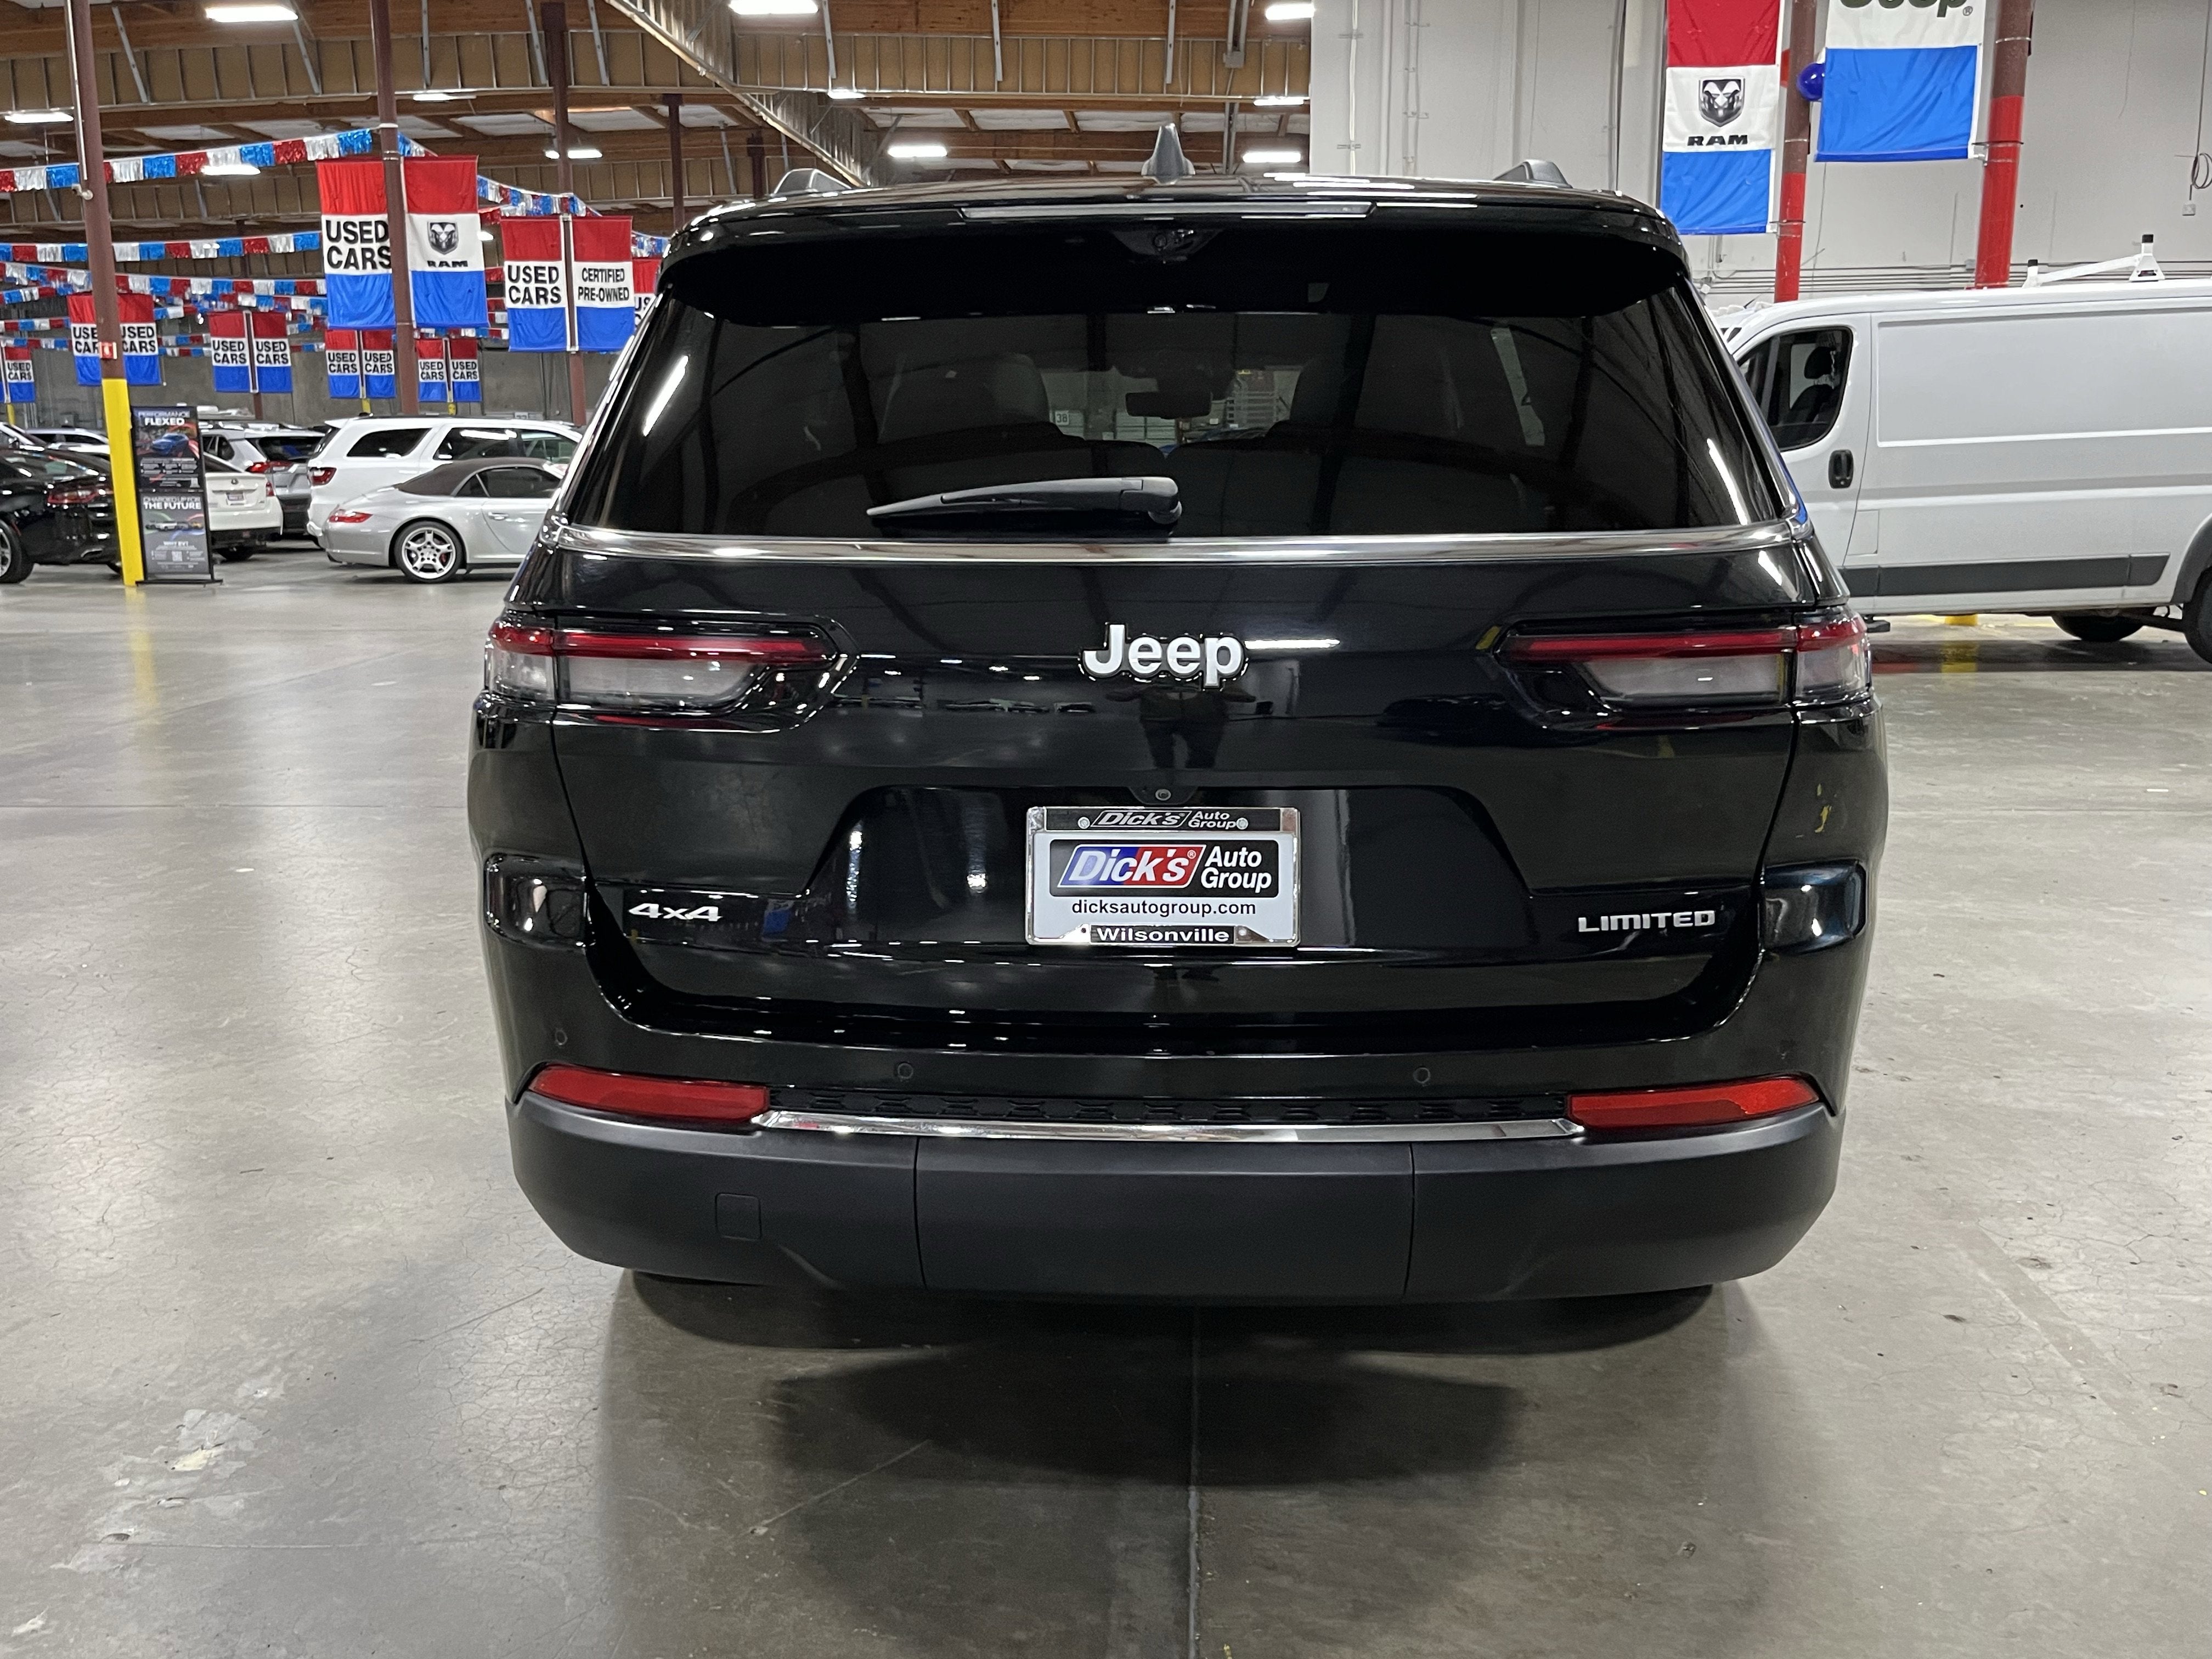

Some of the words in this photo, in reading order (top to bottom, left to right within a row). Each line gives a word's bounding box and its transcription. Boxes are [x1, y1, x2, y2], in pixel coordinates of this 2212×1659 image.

[1688, 135, 1748, 146] RAM
[325, 219, 390, 245] USED
[327, 246, 392, 270] CARS
[507, 265, 560, 284] USED
[582, 267, 625, 283] CERTIFIED
[509, 285, 562, 305] CARS
[578, 286, 630, 302] PRE-OWNED
[74, 326, 98, 339] USE
[75, 341, 99, 353] CAR
[122, 341, 156, 353] CARS
[213, 340, 245, 352] USED
[256, 341, 287, 352] USED
[213, 353, 247, 364] CARS
[256, 353, 289, 364] CARS
[328, 352, 356, 362] USED
[364, 352, 392, 363] USED
[7, 362, 31, 371] USED
[329, 363, 357, 373] CARS
[365, 363, 393, 373] CARS
[420, 361, 443, 370] USED
[452, 361, 477, 370] USED
[8, 372, 32, 380] CARS
[421, 371, 444, 380] CARS
[453, 370, 478, 380] CARS
[144, 417, 185, 426] FLEXED
[1057, 414, 1068, 422] 38
[1083, 624, 1244, 687] Jeep
[1098, 812, 1181, 825] Dick's
[1192, 811, 1231, 820] Auto
[1188, 819, 1237, 830] Group
[1068, 849, 1189, 882] Dick's
[1205, 846, 1262, 868] Auto
[1201, 868, 1272, 894] Group
[628, 903, 723, 922] 4x4
[1071, 900, 1256, 917] dicksautogroup.com
[1578, 910, 1715, 932] LIMITED
[1097, 927, 1229, 943] Wilsonville
